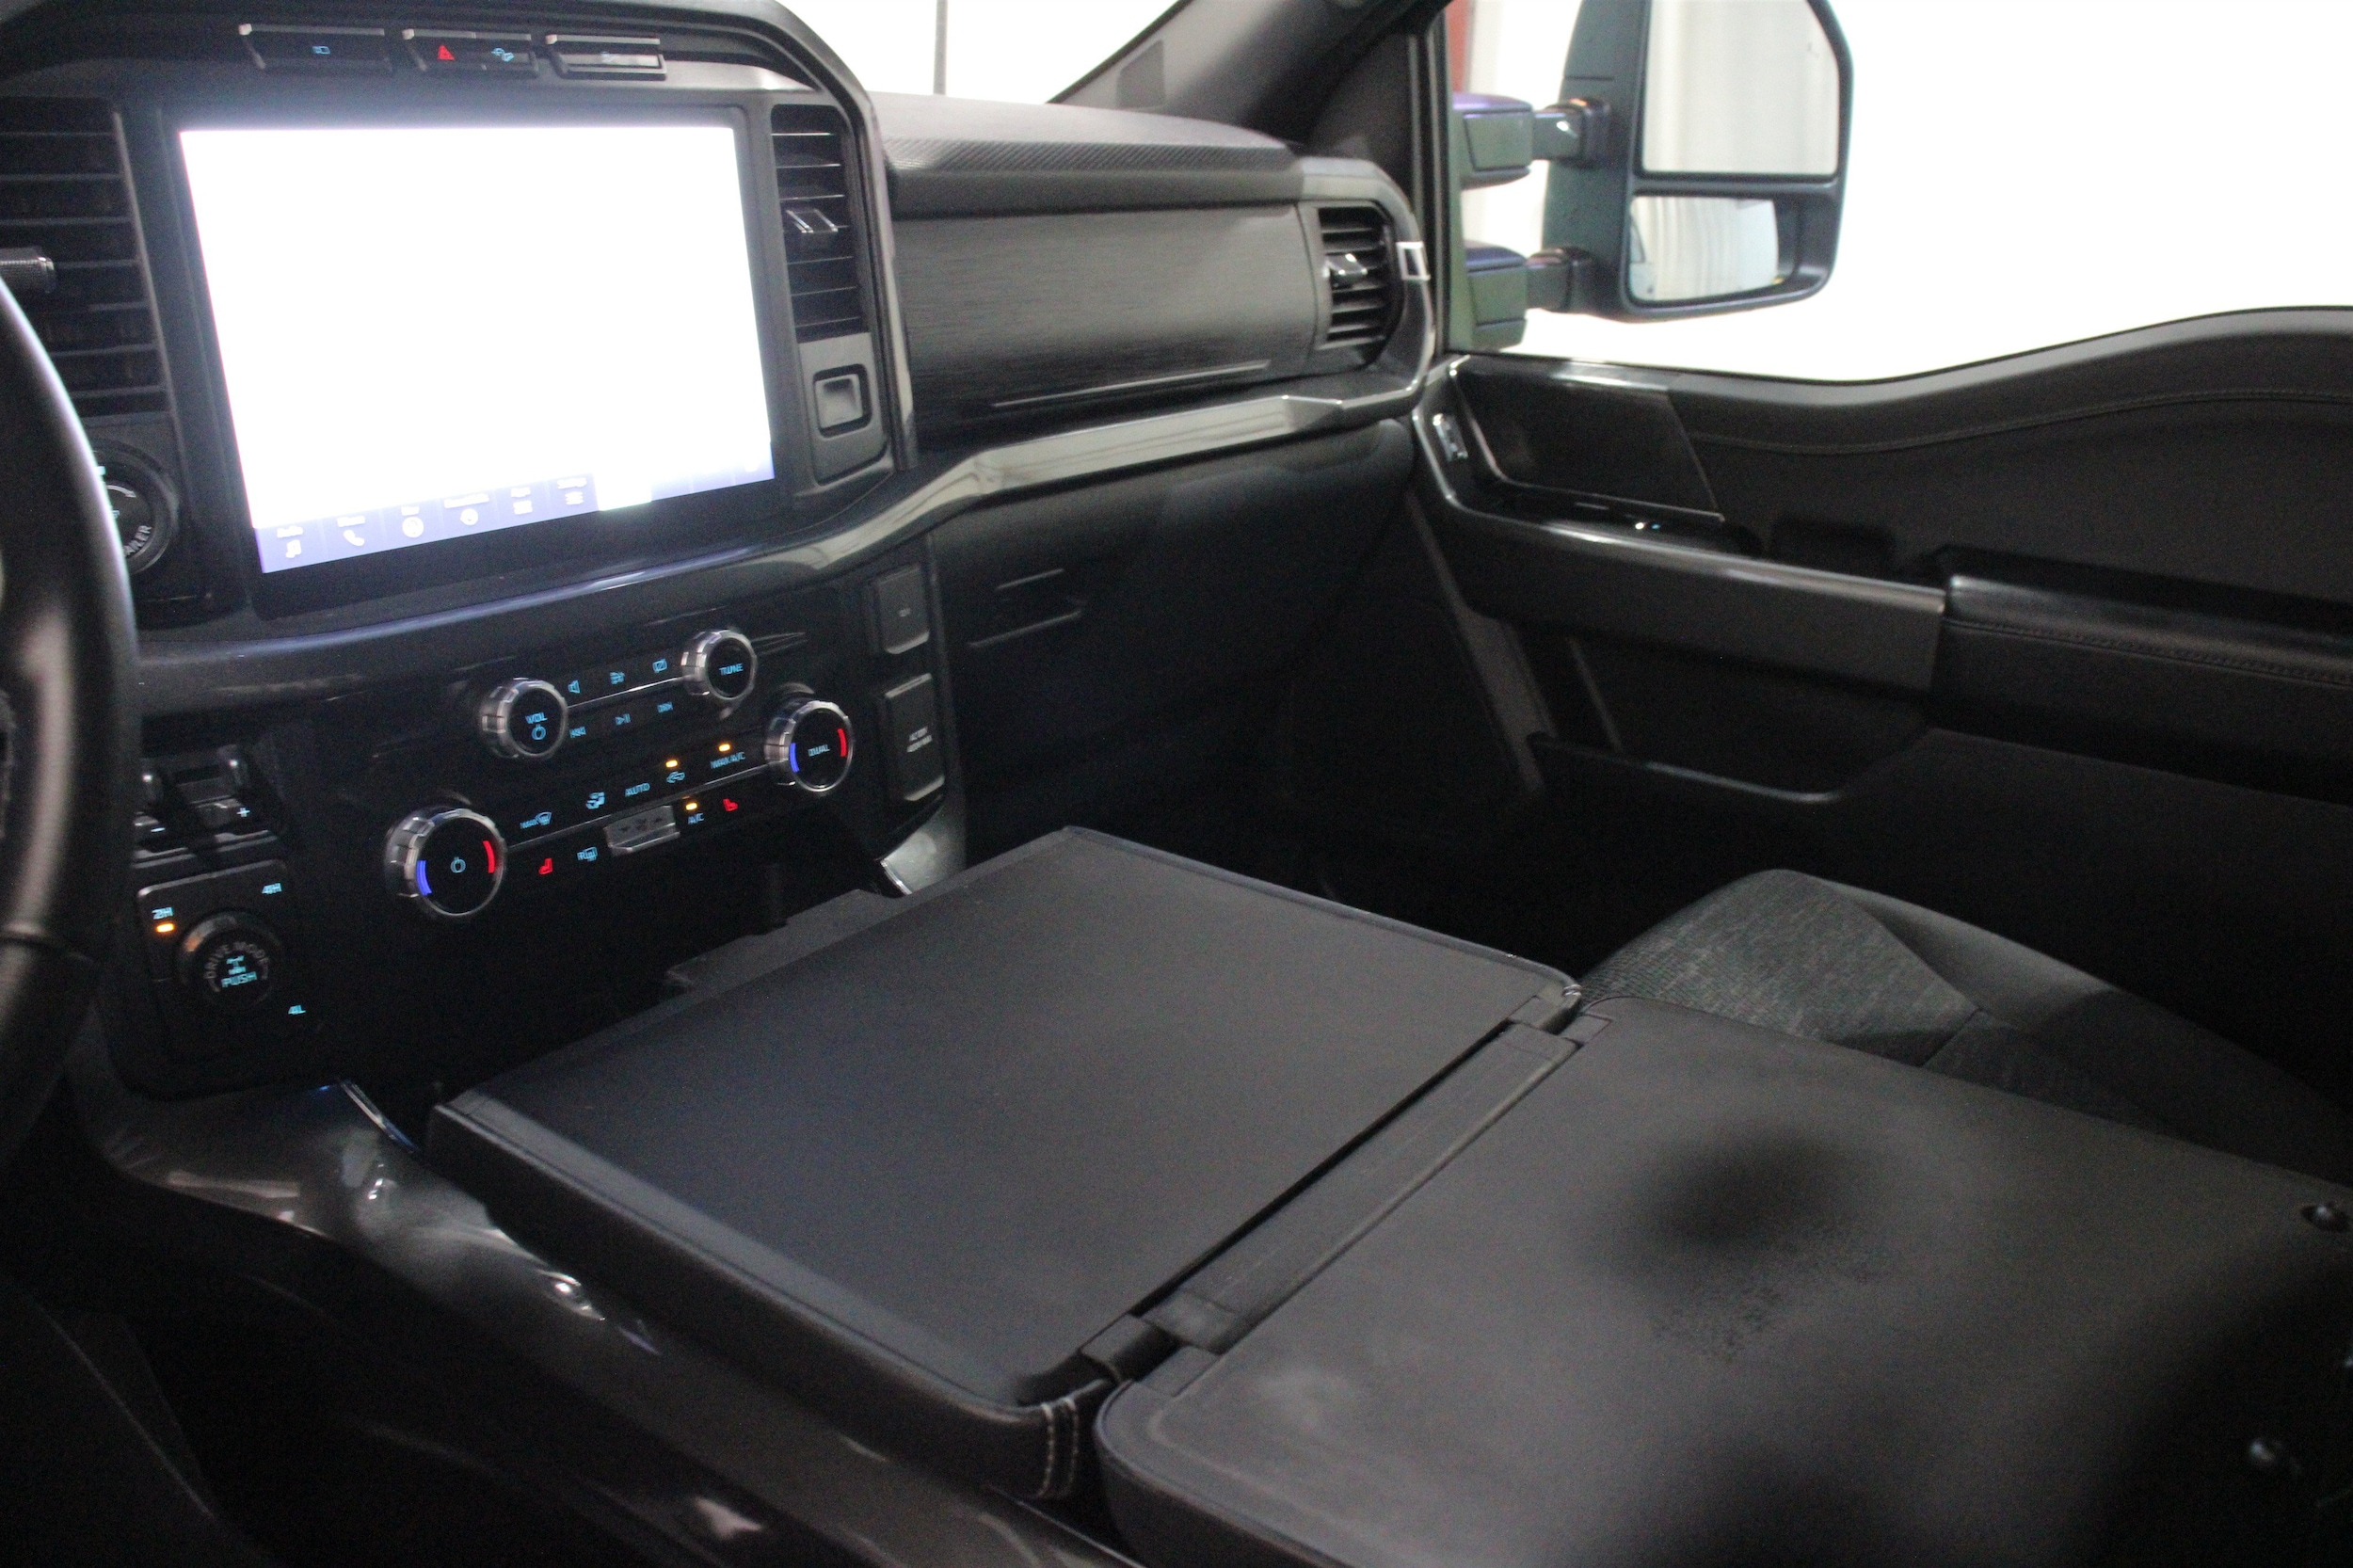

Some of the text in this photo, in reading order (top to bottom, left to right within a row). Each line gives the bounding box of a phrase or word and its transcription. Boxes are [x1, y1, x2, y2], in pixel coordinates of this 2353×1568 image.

[719, 663, 744, 676] TUNE
[525, 712, 548, 725] VOL
[808, 744, 830, 757] DUAL
[624, 782, 650, 797] AUTO
[152, 906, 174, 920] 2H
[220, 971, 258, 988] PUSH
